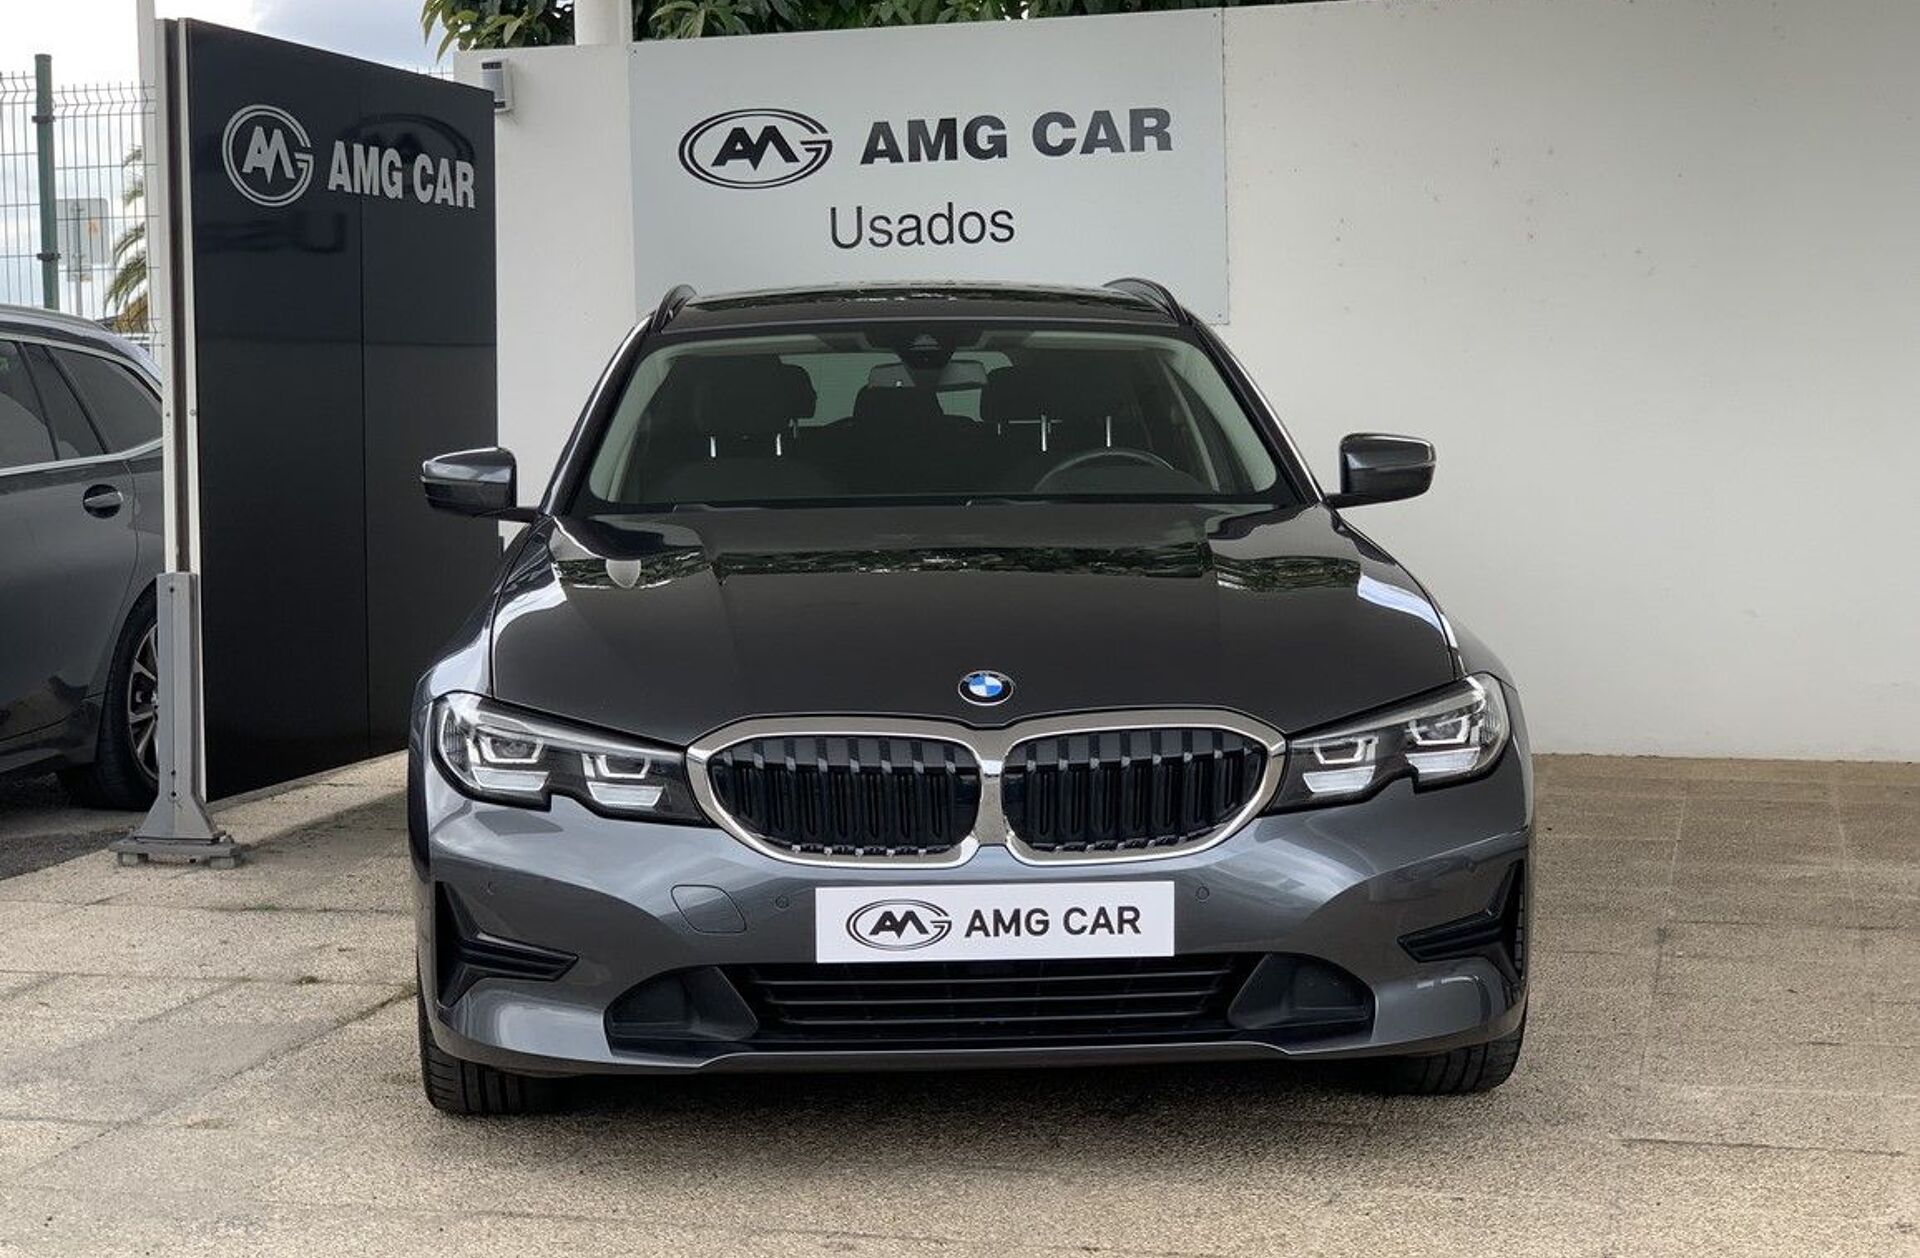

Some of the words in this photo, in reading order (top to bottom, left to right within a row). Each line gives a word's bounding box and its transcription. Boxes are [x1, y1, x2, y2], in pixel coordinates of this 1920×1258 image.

[859, 114, 1008, 165] AMG
[1031, 107, 1174, 158] CAR
[327, 139, 404, 200] AMG
[412, 152, 477, 209] CAR
[830, 201, 1016, 250] Usados
[964, 907, 1050, 938] AMG
[1062, 905, 1142, 936] CAR
